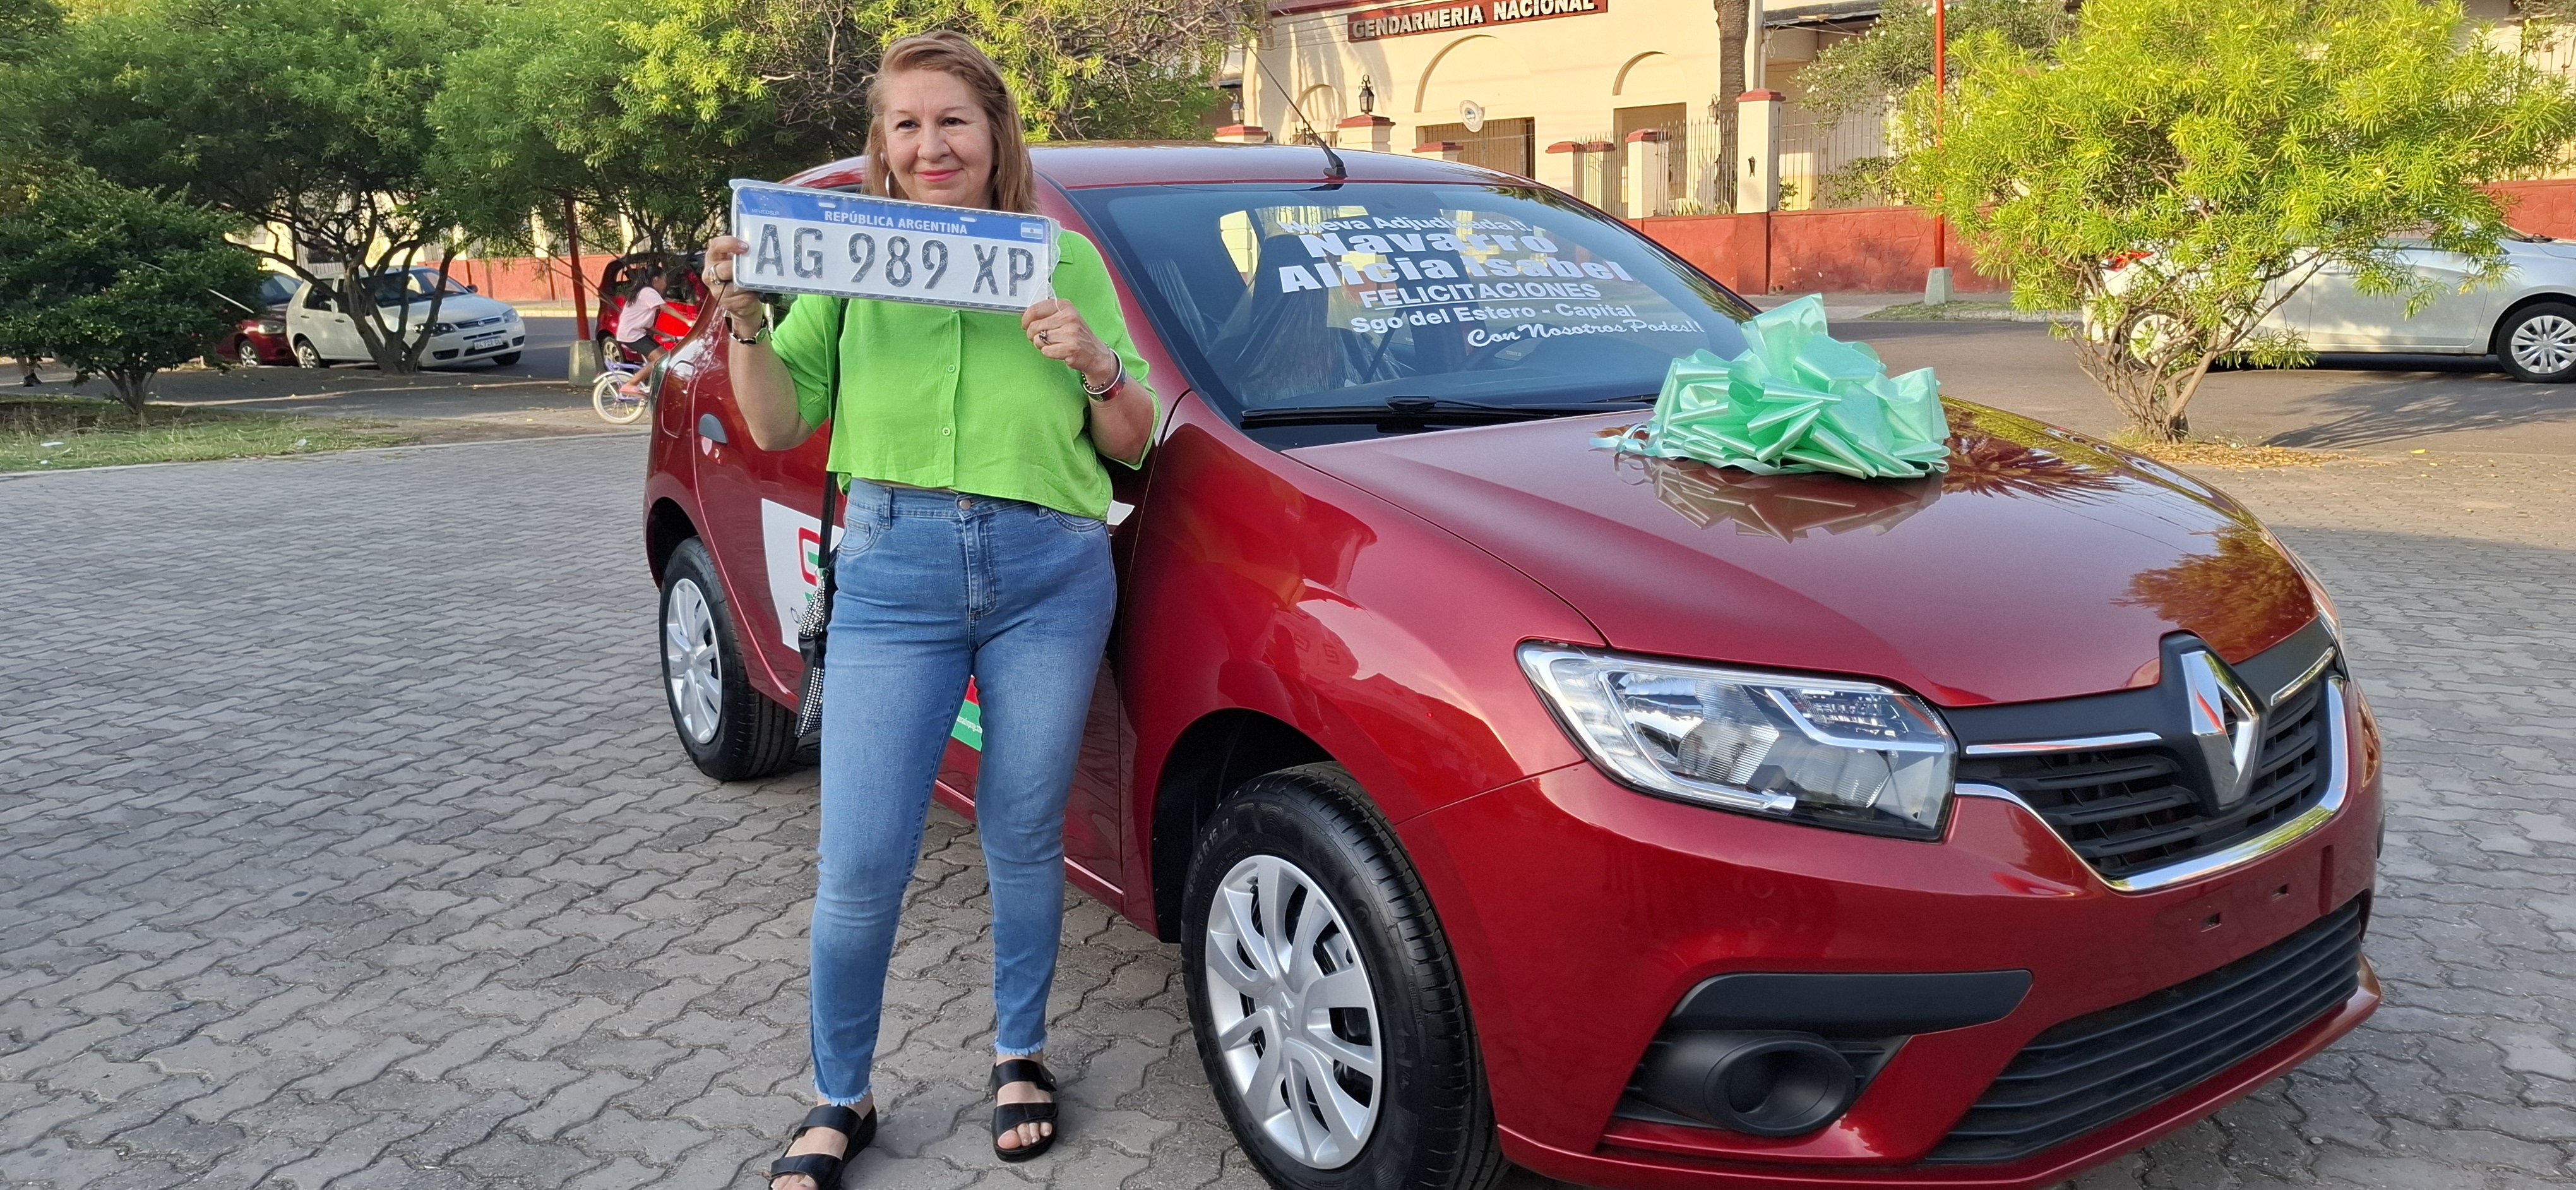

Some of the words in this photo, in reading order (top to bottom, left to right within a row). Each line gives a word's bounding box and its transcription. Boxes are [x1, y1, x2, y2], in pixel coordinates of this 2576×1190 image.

[1352, 4, 1483, 39] GENDARMERIA
[1493, 0, 1595, 21] NACIONAL
[825, 210, 894, 227] REPÚBLICA
[898, 217, 967, 234] ARGENTINA
[1277, 218, 1371, 234] Nueva
[1372, 217, 1514, 231] Adjudicada
[1298, 232, 1558, 258] Navarro
[755, 224, 823, 280] AG
[848, 232, 948, 290] 989
[972, 243, 1034, 297] XP
[1279, 256, 1458, 293] Alicia
[1460, 255, 1633, 282] Isabel
[1359, 282, 1601, 308] FELICITACIONES
[1351, 316, 1403, 334] Sgo
[1410, 308, 1450, 326] del
[1453, 305, 1537, 322] Estero
[1555, 303, 1637, 319] Capital
[1467, 328, 1520, 347] Con
[1517, 322, 1627, 339] Nosotros
[1623, 319, 1705, 334] Podes!!
